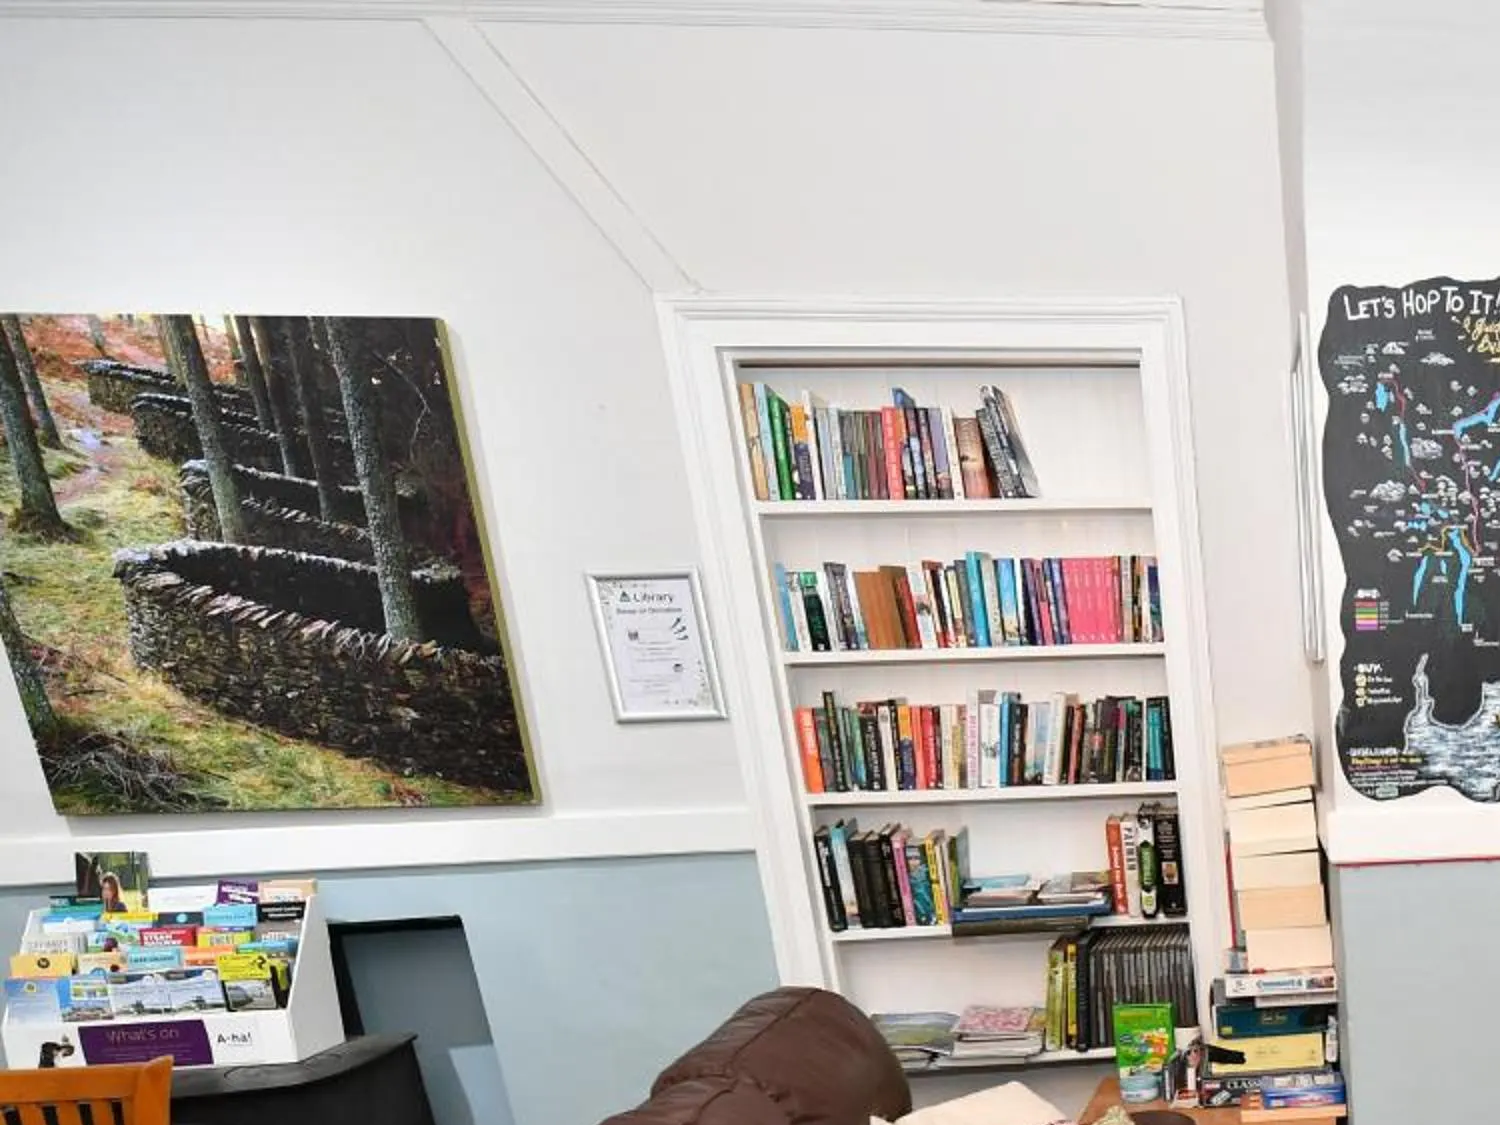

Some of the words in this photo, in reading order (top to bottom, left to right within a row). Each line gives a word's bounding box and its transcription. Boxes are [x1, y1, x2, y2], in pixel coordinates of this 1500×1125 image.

[1343, 294, 1396, 321] LET'S
[1402, 288, 1440, 319] HOP
[633, 591, 675, 604] Library
[106, 1027, 157, 1045] What's
[160, 1027, 180, 1041] on
